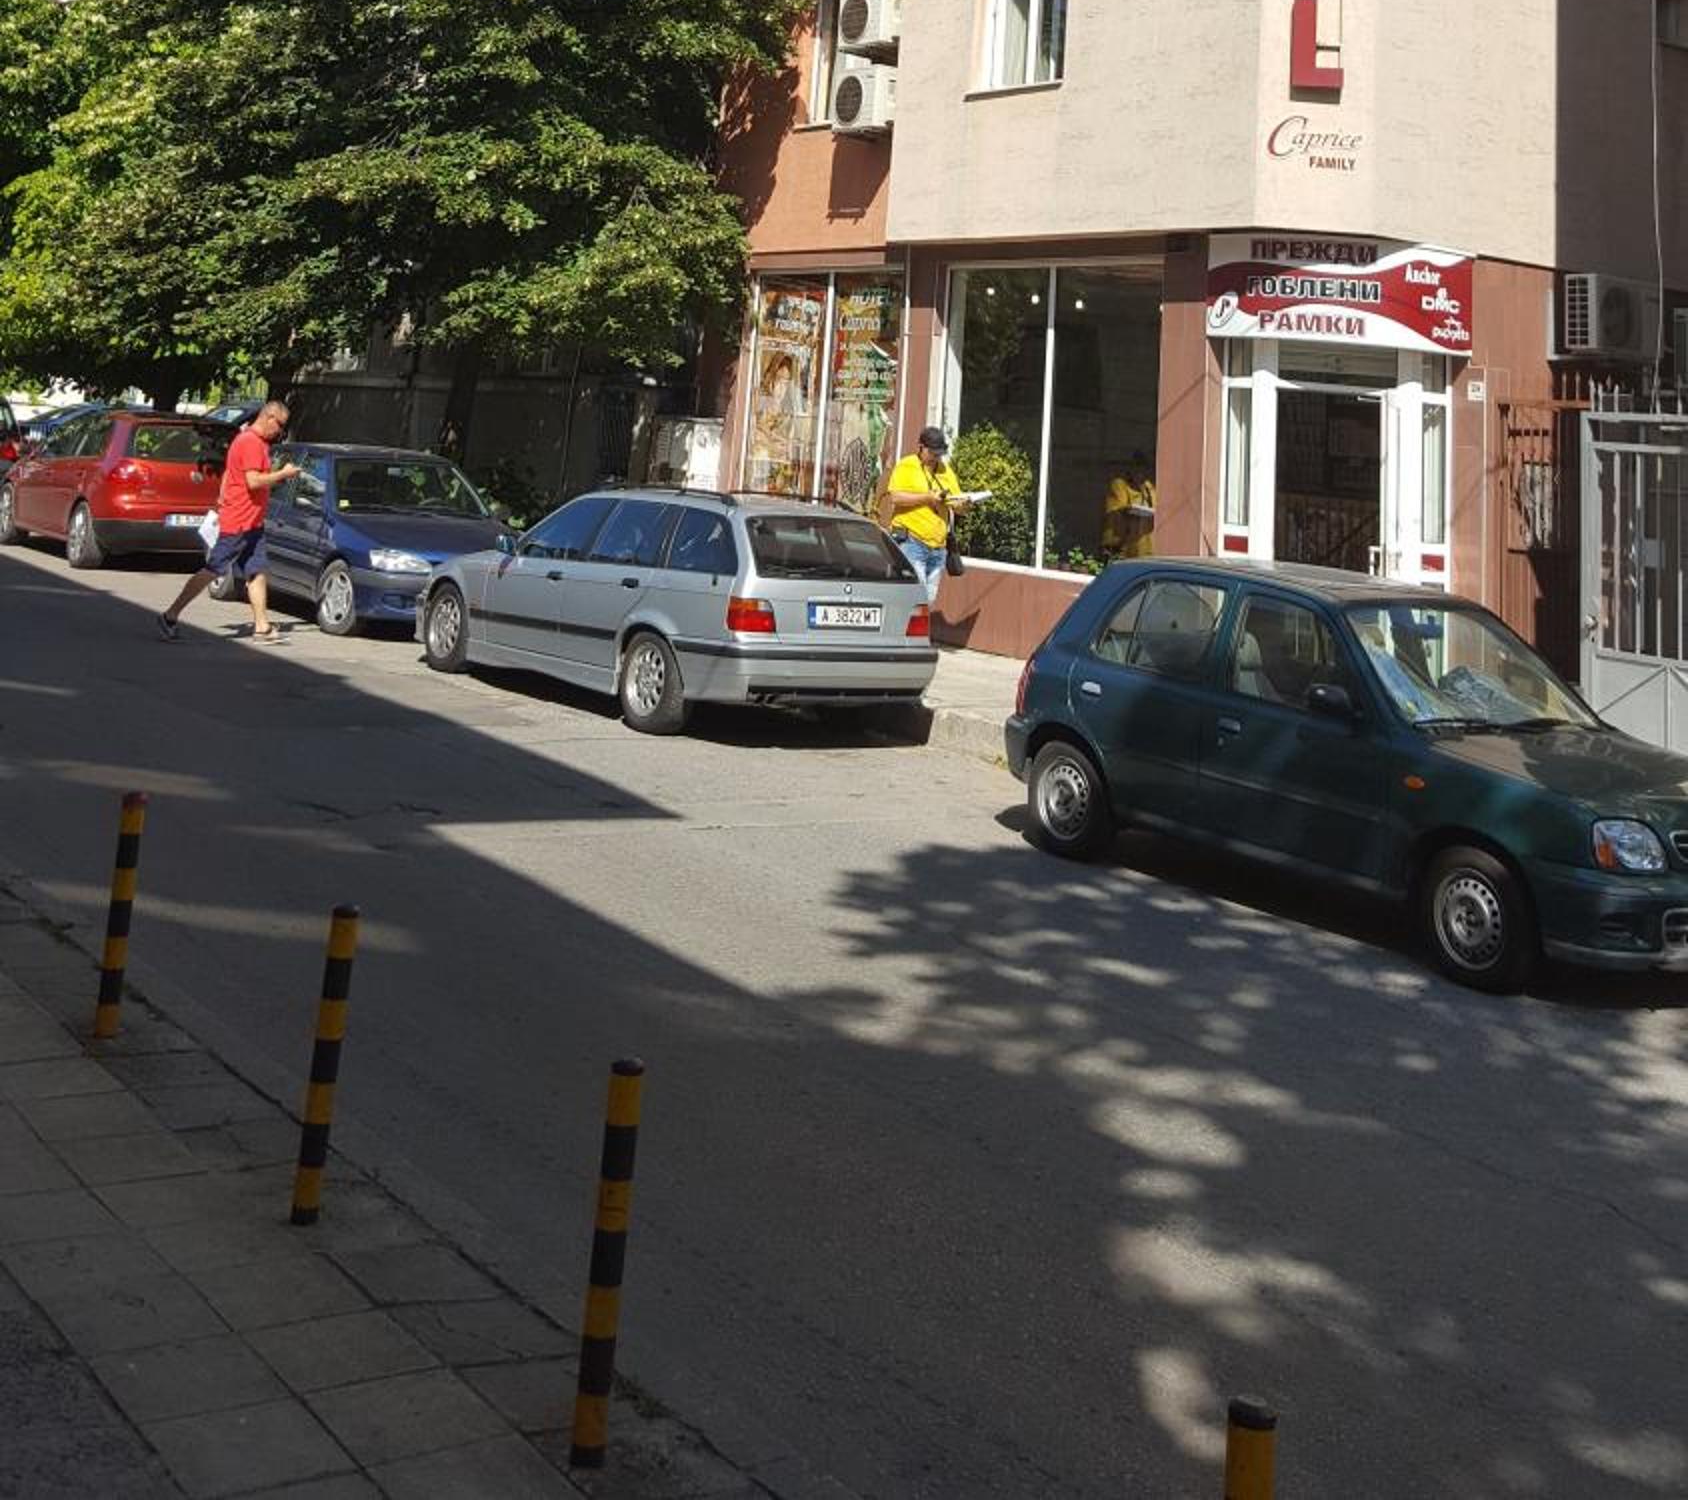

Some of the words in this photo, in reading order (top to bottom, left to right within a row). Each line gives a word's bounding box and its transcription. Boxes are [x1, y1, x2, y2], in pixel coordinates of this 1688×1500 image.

[1267, 115, 1363, 157] Caprice
[1309, 155, 1357, 172] FAMILY
[1250, 238, 1379, 267] ПРЕЖДИ
[1247, 275, 1381, 303] ГОБЛЕНИ
[1421, 295, 1460, 315] DMC
[1258, 310, 1366, 337] РАМКИ
[821, 608, 829, 622] A
